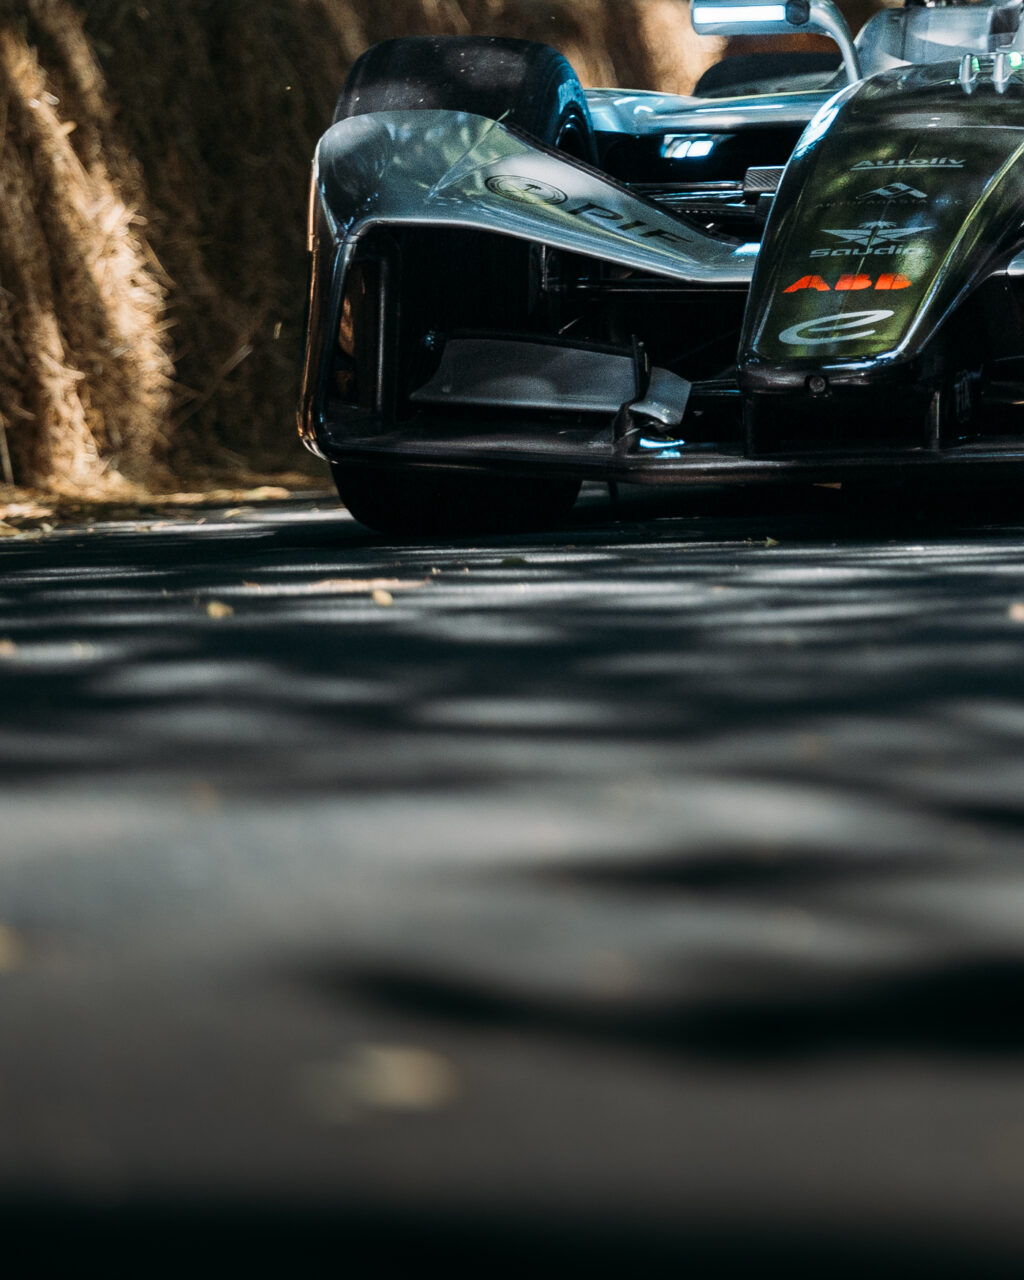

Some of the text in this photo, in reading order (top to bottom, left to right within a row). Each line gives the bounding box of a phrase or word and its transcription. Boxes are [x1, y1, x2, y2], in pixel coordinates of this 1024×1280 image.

[852, 157, 967, 169] Autoliv
[568, 202, 693, 242] PIF
[782, 273, 912, 294] ABB
